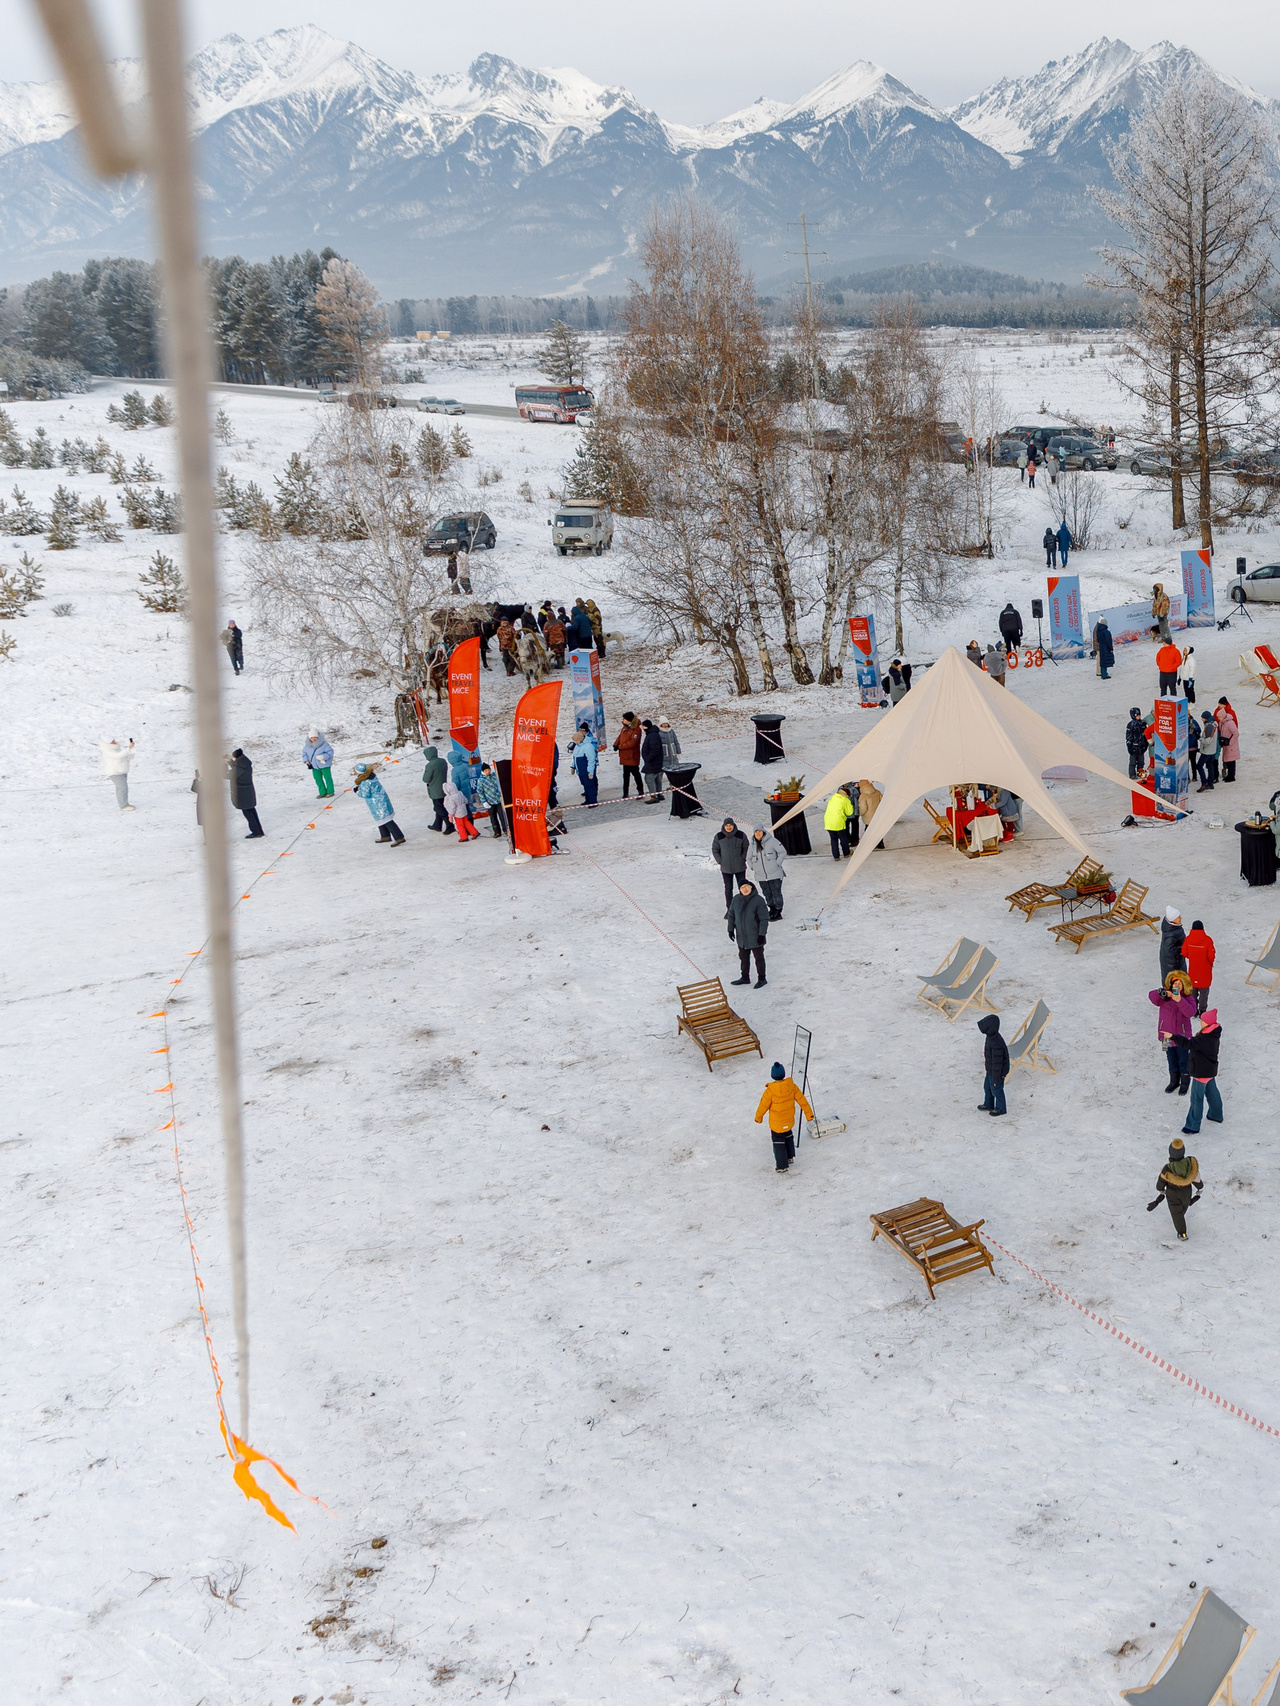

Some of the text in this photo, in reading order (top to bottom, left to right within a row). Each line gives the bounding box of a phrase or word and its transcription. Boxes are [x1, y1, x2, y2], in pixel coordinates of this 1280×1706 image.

[518, 718, 546, 727] EVENT
[518, 726, 549, 735] TRAVEL
[517, 734, 540, 742] MICE
[515, 798, 542, 806] EVENT
